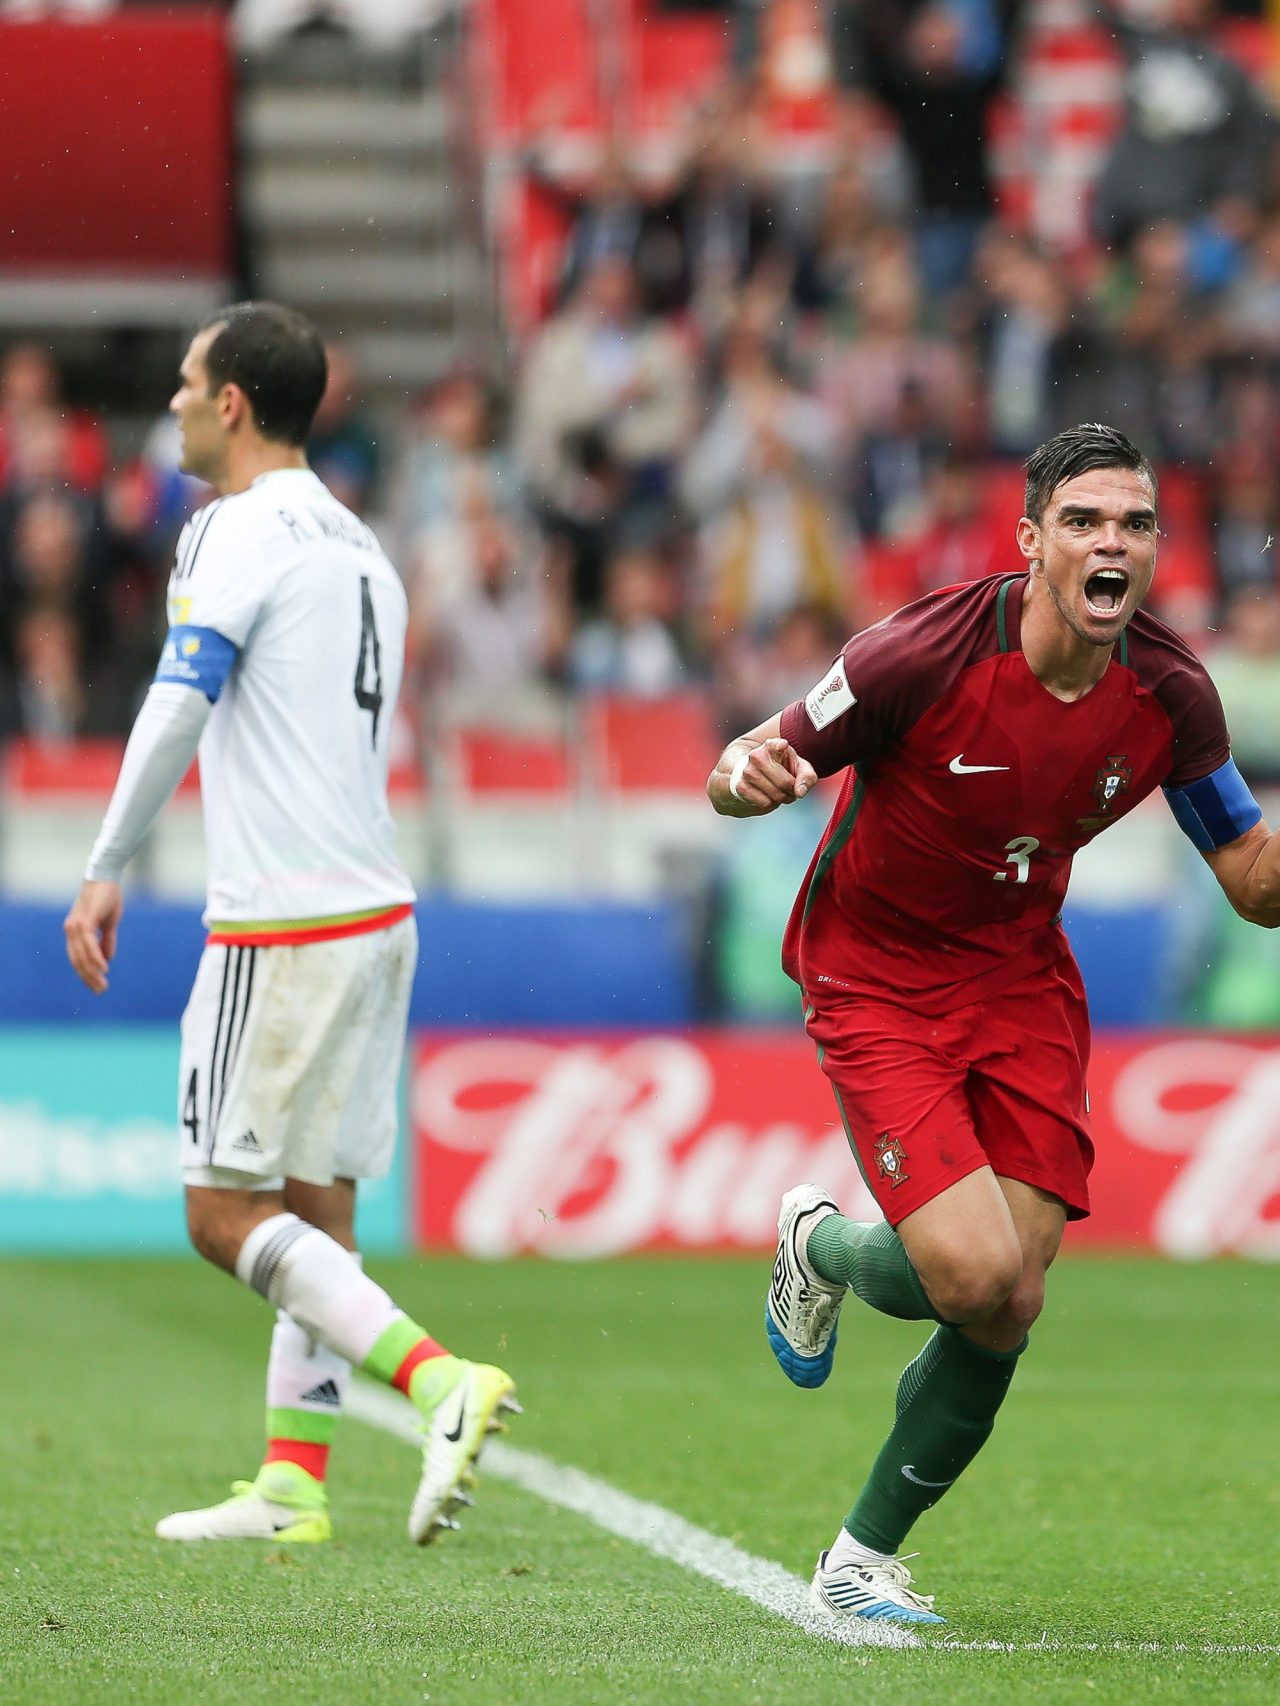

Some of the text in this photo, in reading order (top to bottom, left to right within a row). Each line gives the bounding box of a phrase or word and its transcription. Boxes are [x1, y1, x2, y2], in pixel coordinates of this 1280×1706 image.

[354, 576, 383, 752] 4
[993, 836, 1040, 884] 3
[183, 1067, 200, 1144] 4
